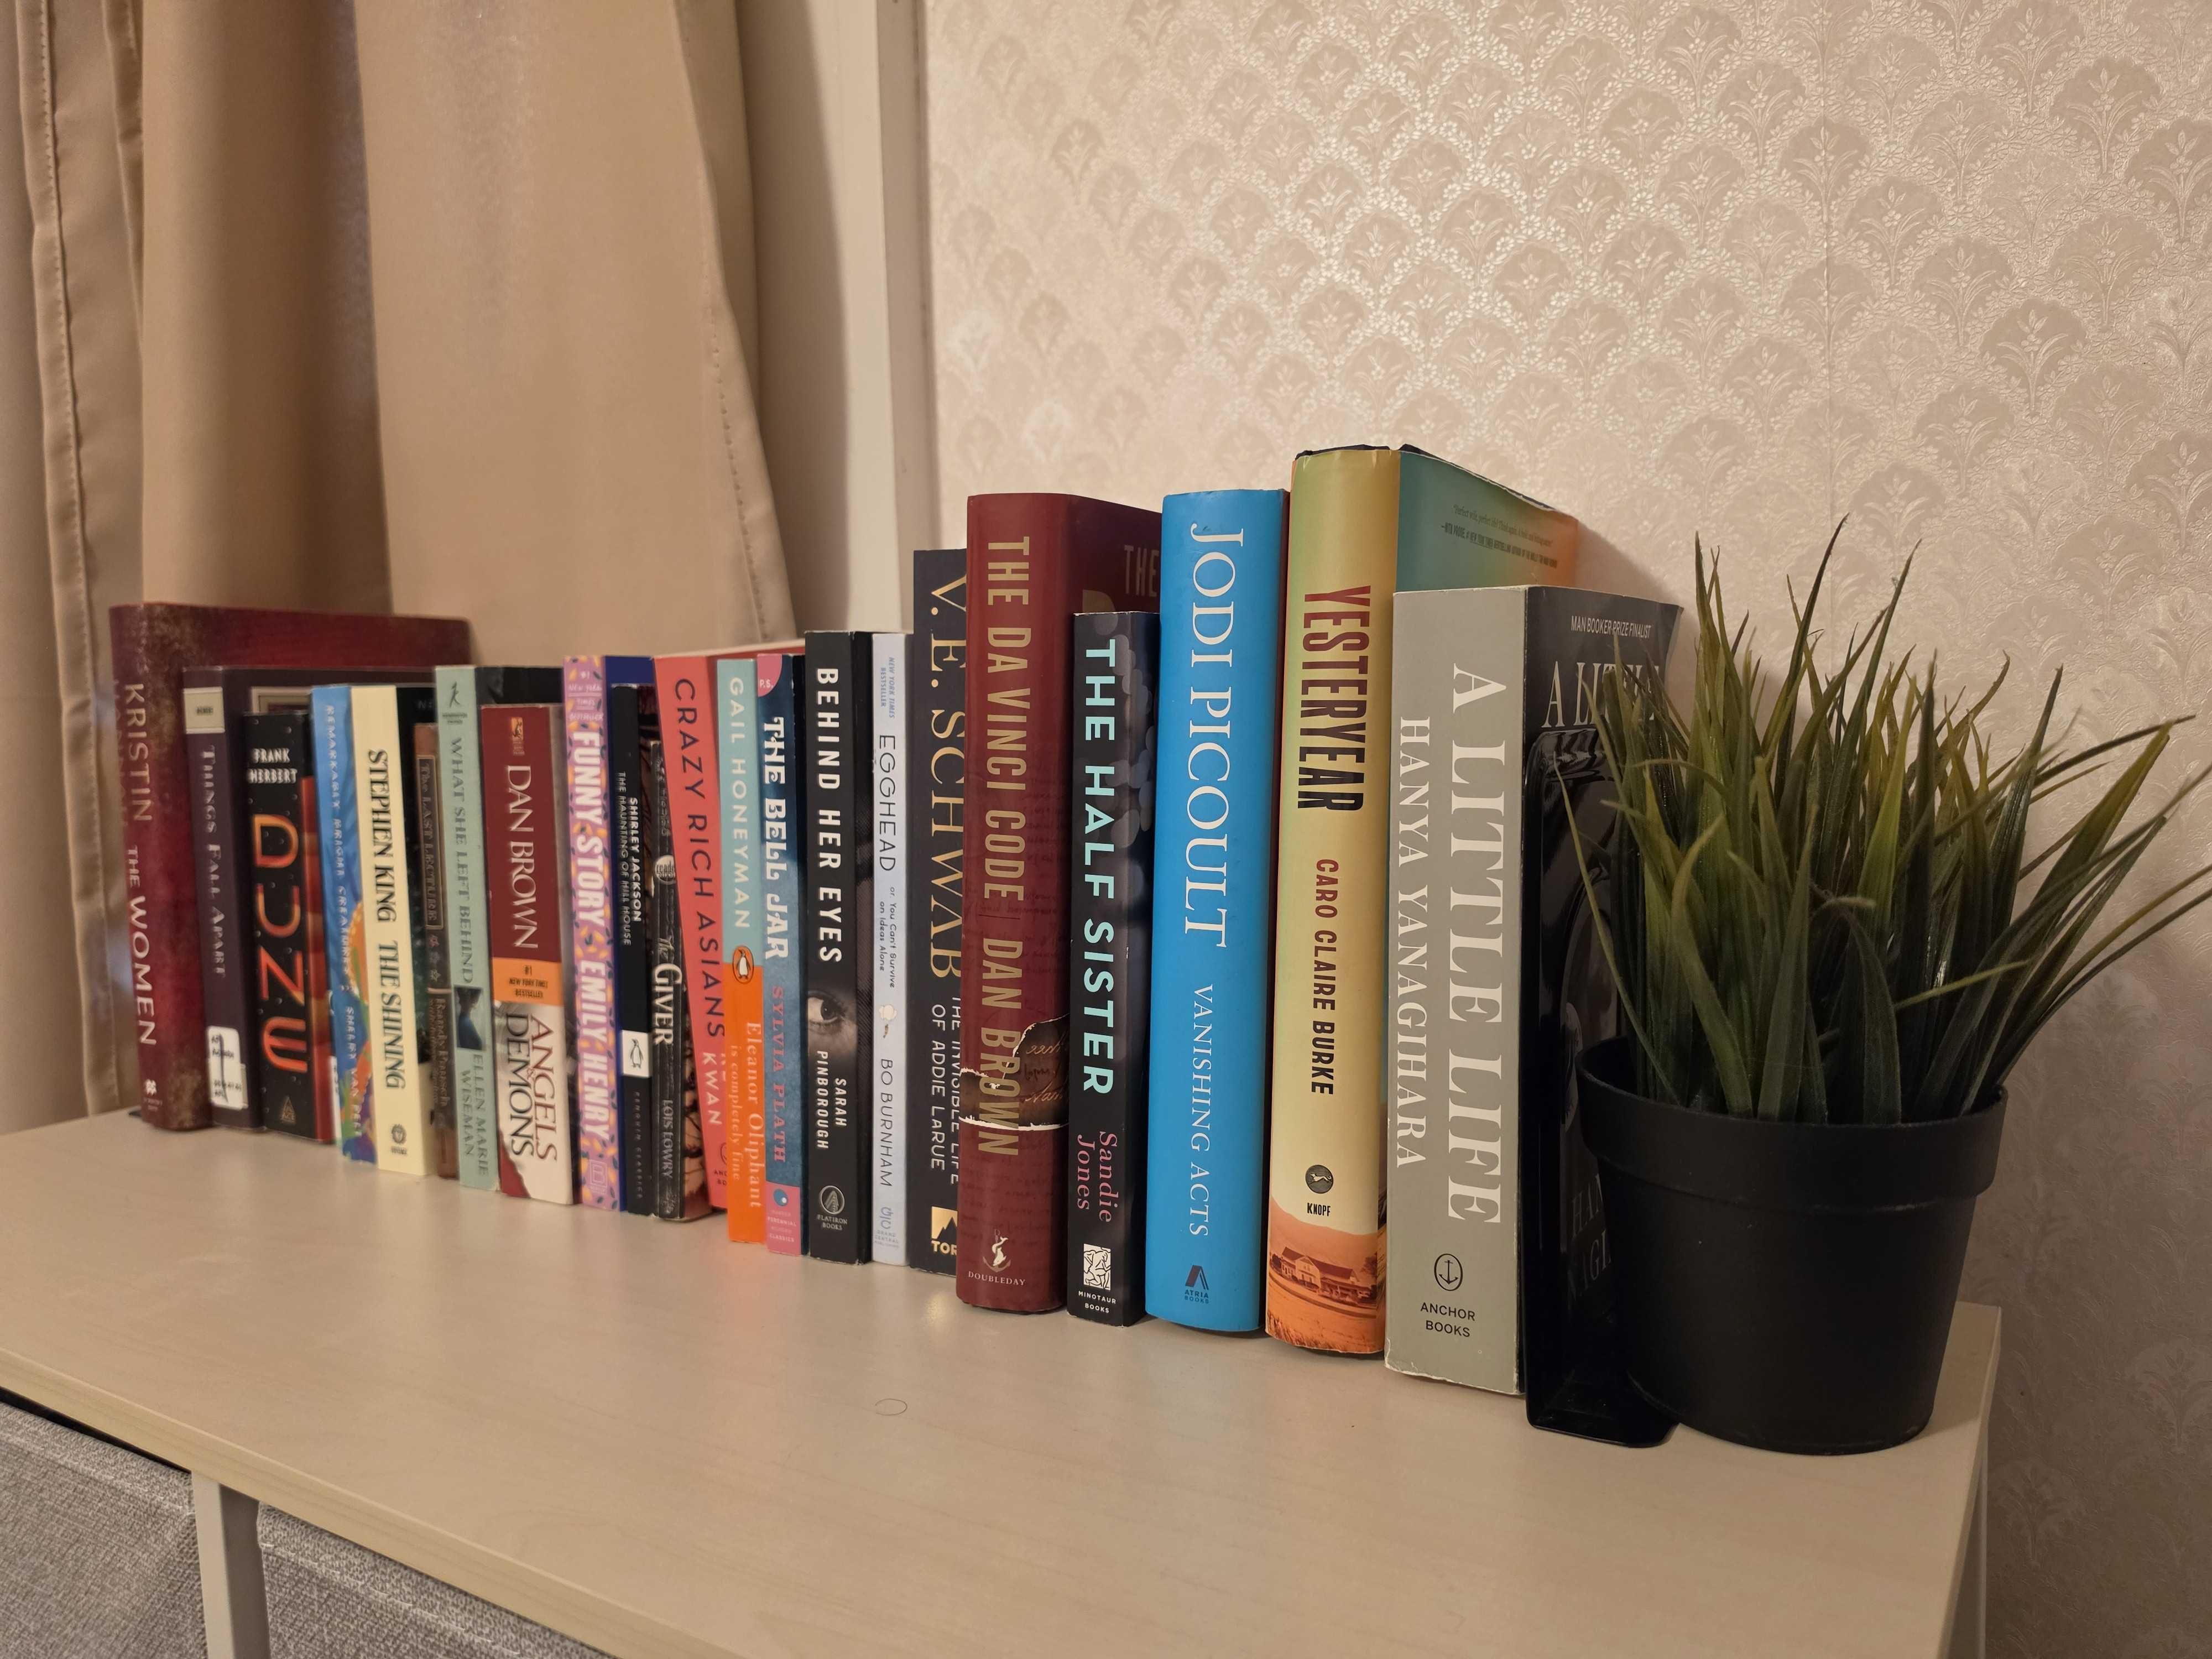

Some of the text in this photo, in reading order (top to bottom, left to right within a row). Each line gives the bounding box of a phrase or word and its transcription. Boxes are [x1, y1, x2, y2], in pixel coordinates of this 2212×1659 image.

[1571, 615, 1652, 639] MAN BOOKER PRIZE FINALIST
[984, 536, 1031, 901] THE DA VINCI CODE
[1185, 523, 1244, 948] JODI PICOULT
[1298, 585, 1371, 811] YESTERYEAR
[1541, 661, 1565, 728] A
[124, 684, 153, 822] KRISTIN
[247, 768, 298, 784] HERBERT
[253, 748, 290, 763] FRANK
[326, 705, 341, 808] REMARKABLY
[451, 738, 464, 801] WHAT
[507, 765, 534, 832] DAN
[618, 773, 626, 792] THE
[332, 817, 345, 878] BRIGHT
[368, 749, 397, 923] STEPHEN KING
[454, 807, 467, 845] SHE
[573, 731, 605, 925] FUNNY STORY
[619, 795, 629, 858] HAUNTING
[729, 677, 750, 928] GAIL HONEYMAN
[764, 717, 789, 960] THE BELL JAR
[817, 667, 842, 963] BEHIND HER EYES
[879, 734, 896, 872] EGGHEAD
[931, 709, 965, 978] SCHWAB
[457, 852, 469, 900] LEFT
[510, 840, 539, 949] BROWN
[622, 860, 629, 878] OF
[629, 798, 642, 922] SHIRLEY JACKSON
[674, 679, 725, 1037] CRAZY RICH ASIANS
[1083, 639, 1115, 1094] THE HALF SISTER
[127, 844, 157, 1045] THE WOMEN
[252, 814, 308, 1073] DUNE
[458, 903, 473, 984] BEHIND
[623, 913, 632, 946] HOUSE
[880, 901, 885, 913] on
[1397, 716, 1431, 1168] HANYA YANAGIHARA
[1447, 662, 1506, 1223] A LITTLE LIFE
[379, 940, 406, 1090] THE SHINING
[509, 977, 548, 989] NEW YORK TIMES
[514, 988, 543, 999] BESTSELLER
[653, 935, 683, 1046] The GIVER
[1311, 859, 1339, 1095] CARO CLAIRE BURKE
[345, 1006, 357, 1058] SHELBY
[580, 959, 609, 1141] EMILY HENRY
[772, 987, 786, 1164] SYLVIA PLATH
[978, 938, 1023, 1156] DAN BROWN
[460, 1070, 474, 1156] WISEMAN
[473, 1054, 489, 1176] ELLEN MARIE
[505, 1013, 535, 1157] DEMONS
[530, 1013, 558, 1161] ANGELS
[663, 1099, 673, 1128] LOIS
[703, 1052, 723, 1125] KWAN
[727, 1045, 743, 1181] is completely fine
[746, 1022, 766, 1208] Eleanor Oliphant
[816, 1050, 830, 1150] PINBOROUGH
[834, 1078, 847, 1127] SARAH
[880, 1058, 893, 1187] BO BURNHAM
[931, 1004, 946, 1170] OF ADDIE LARUE
[1189, 984, 1214, 1237] VANISHING ACTS
[662, 1130, 674, 1178] LOWRY
[1077, 1135, 1095, 1211] Jones
[1098, 1131, 1119, 1222] Sandie
[817, 1214, 848, 1225] FLATIRON
[822, 1222, 843, 1231] BOOKS
[931, 1240, 957, 1255] TOR
[1307, 1202, 1331, 1217] KNOPF
[968, 1270, 1026, 1287] DOUBLEDAY
[1078, 1290, 1117, 1304] MINOTAUR
[1084, 1302, 1110, 1313] BOOKS
[1185, 1290, 1208, 1298] ATRIA
[1185, 1295, 1209, 1304] BOOKS
[1420, 1302, 1476, 1322] ANCHOR
[1425, 1319, 1471, 1338] BOOKS
